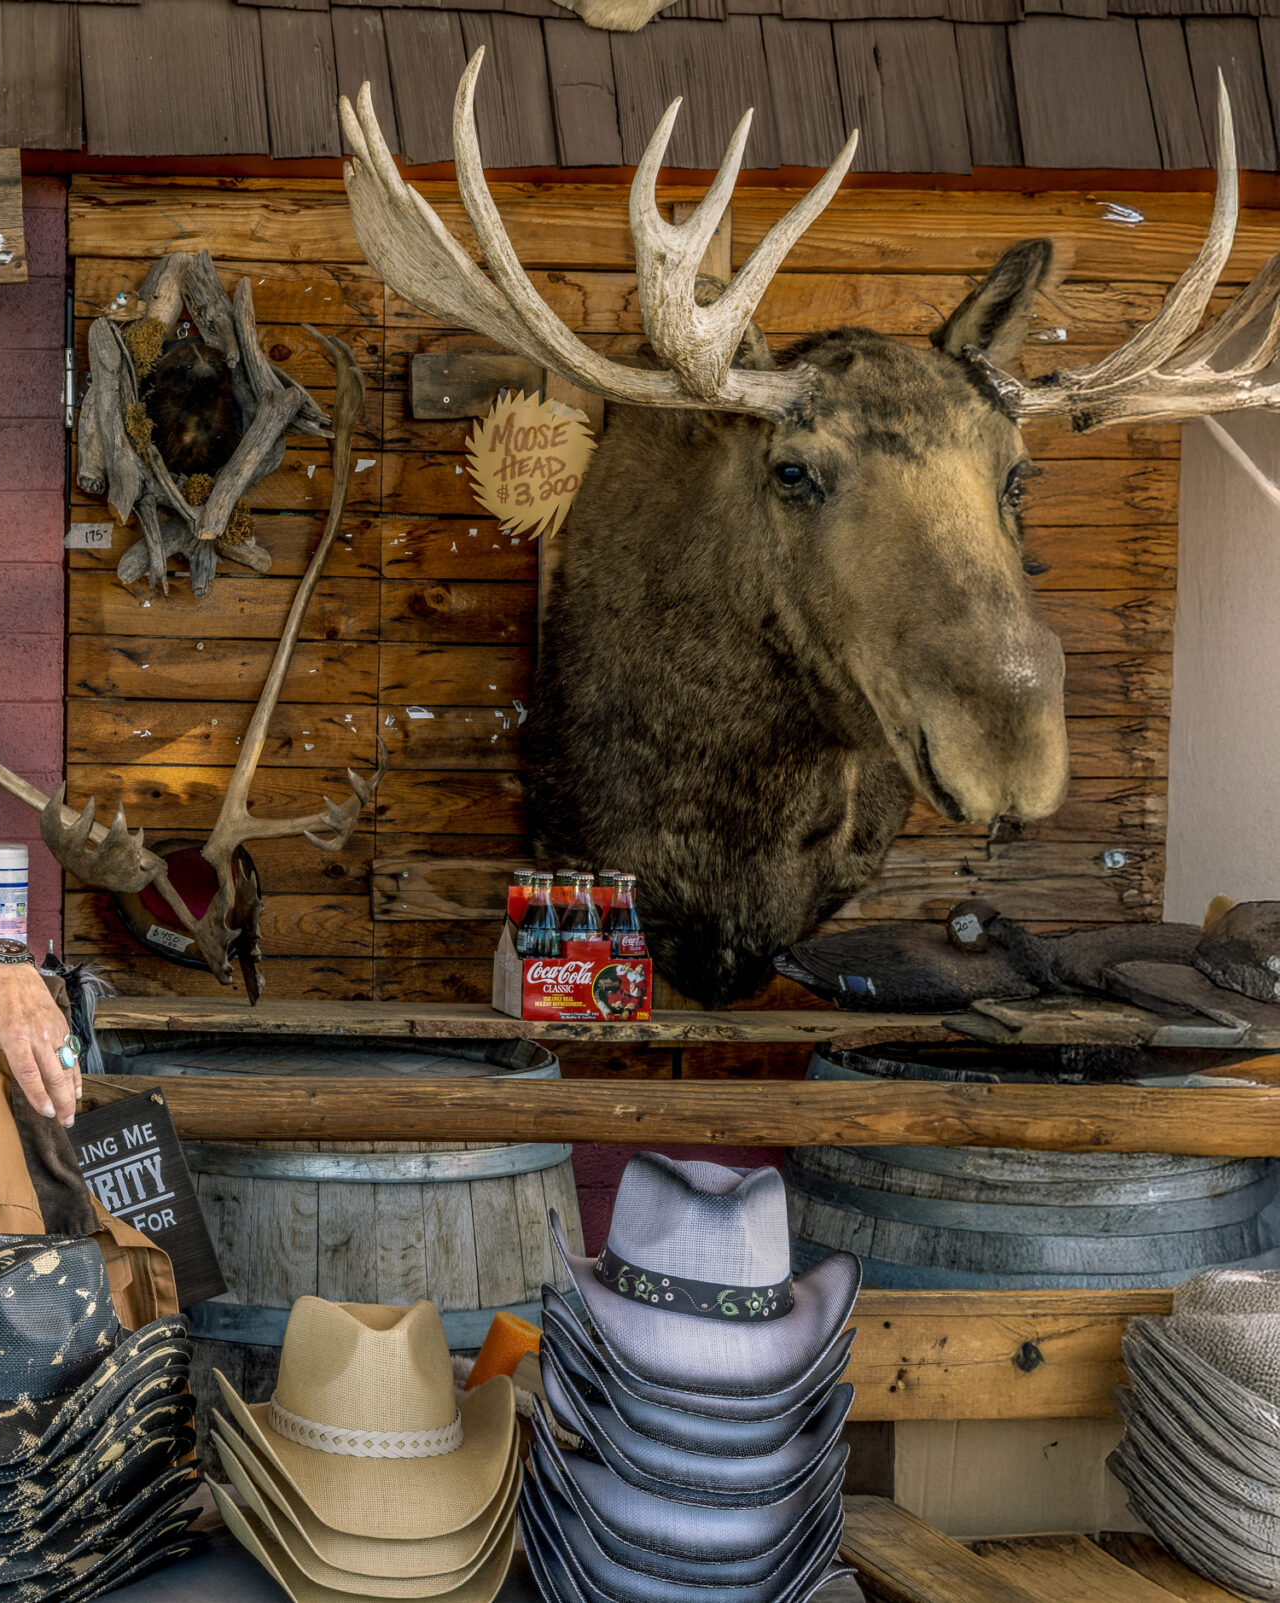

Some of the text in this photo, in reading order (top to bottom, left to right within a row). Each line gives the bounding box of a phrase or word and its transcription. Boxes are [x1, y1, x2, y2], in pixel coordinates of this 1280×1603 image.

[488, 411, 572, 458] MOOSE
[492, 455, 568, 482] HEAD
[526, 960, 596, 985] Coca-Cola
[542, 984, 575, 994] CLASSIC
[79, 1122, 158, 1167] ING ME
[132, 1208, 178, 1234] FOR
